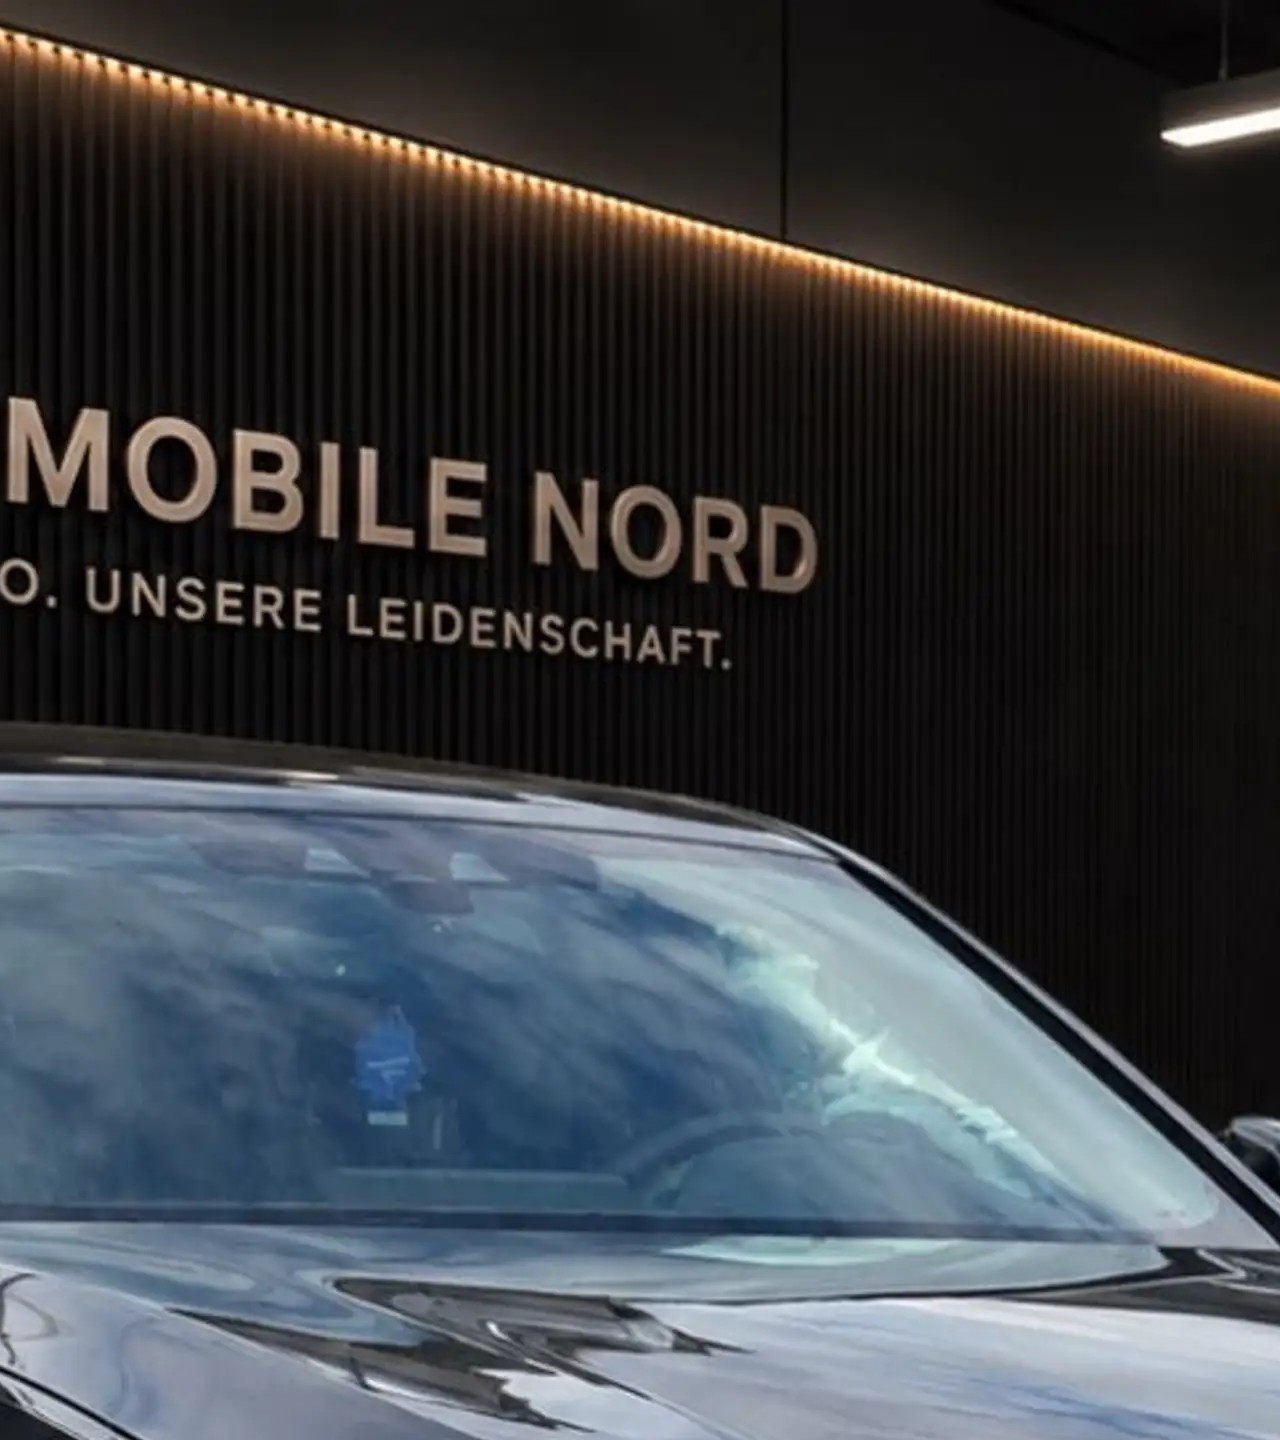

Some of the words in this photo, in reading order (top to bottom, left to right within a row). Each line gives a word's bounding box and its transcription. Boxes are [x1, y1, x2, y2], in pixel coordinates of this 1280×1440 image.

[532, 470, 820, 595] NORD
[84, 566, 324, 634] UNSERE
[346, 593, 734, 671] LEIDENSCHAFT.
